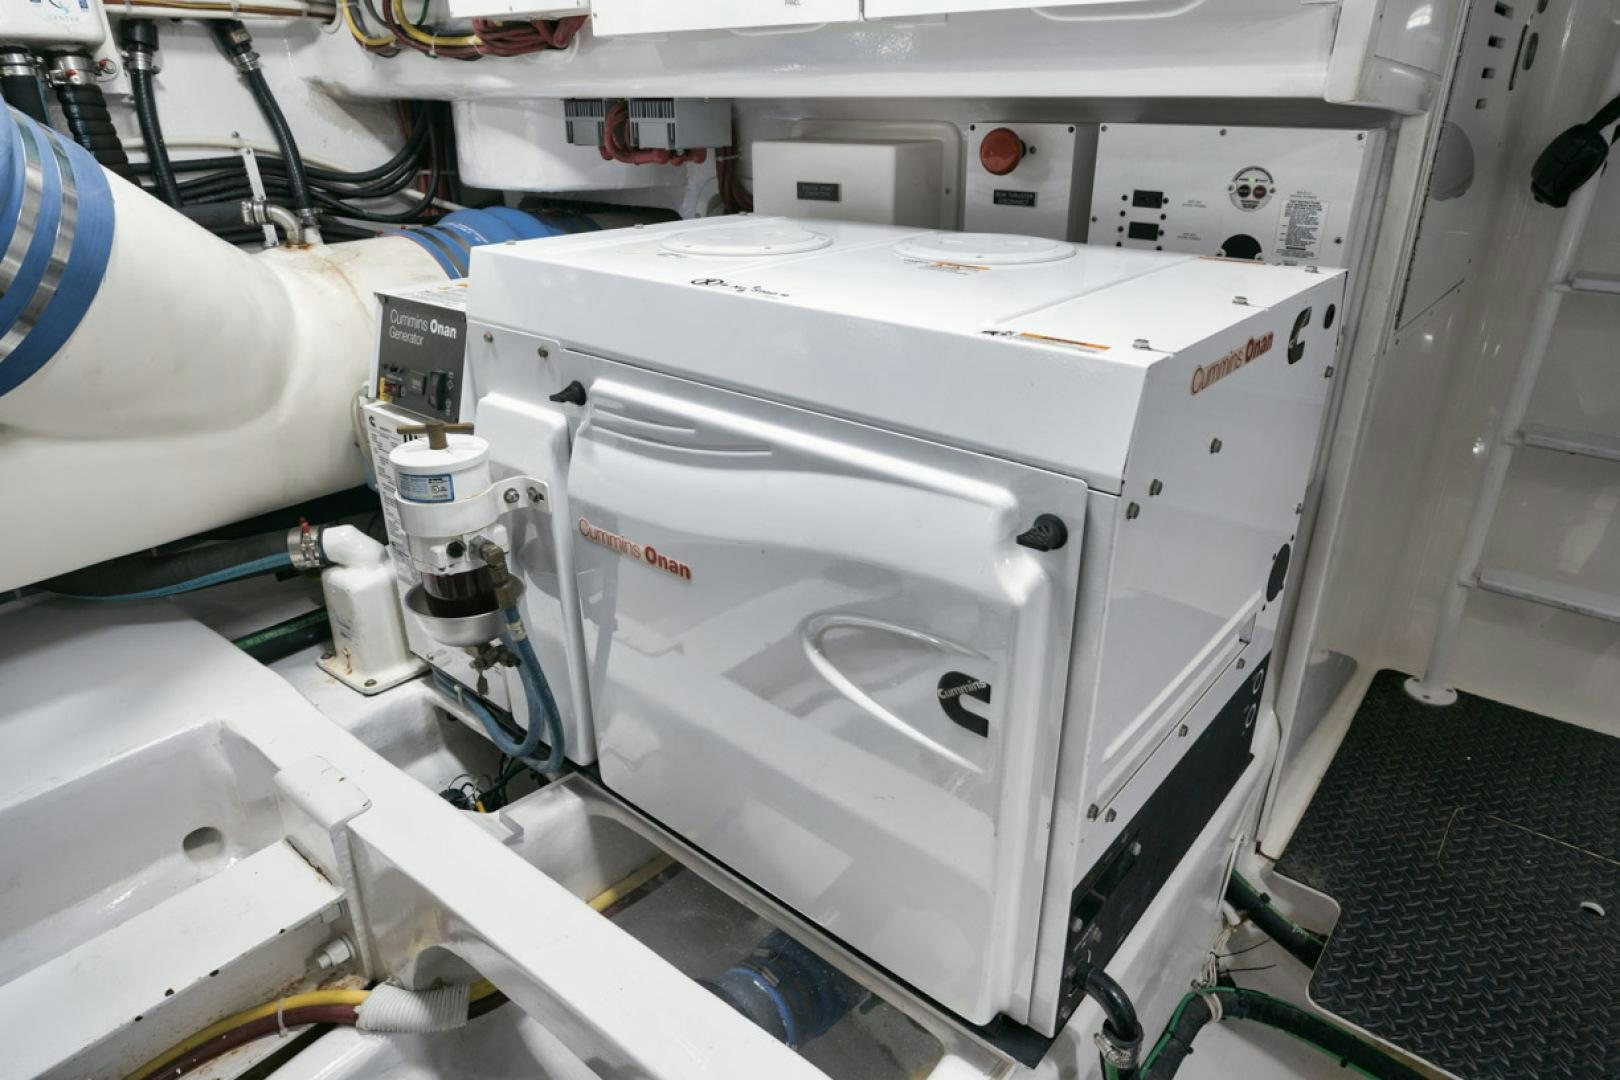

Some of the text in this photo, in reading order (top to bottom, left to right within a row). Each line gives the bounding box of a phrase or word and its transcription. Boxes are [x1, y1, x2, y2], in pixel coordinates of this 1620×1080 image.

[388, 325, 424, 345] Generator
[390, 308, 457, 339] Cummins Onan
[1191, 331, 1273, 395] Cummins Onan
[579, 517, 692, 581] Cummins Onan
[937, 680, 987, 699] Cummins
